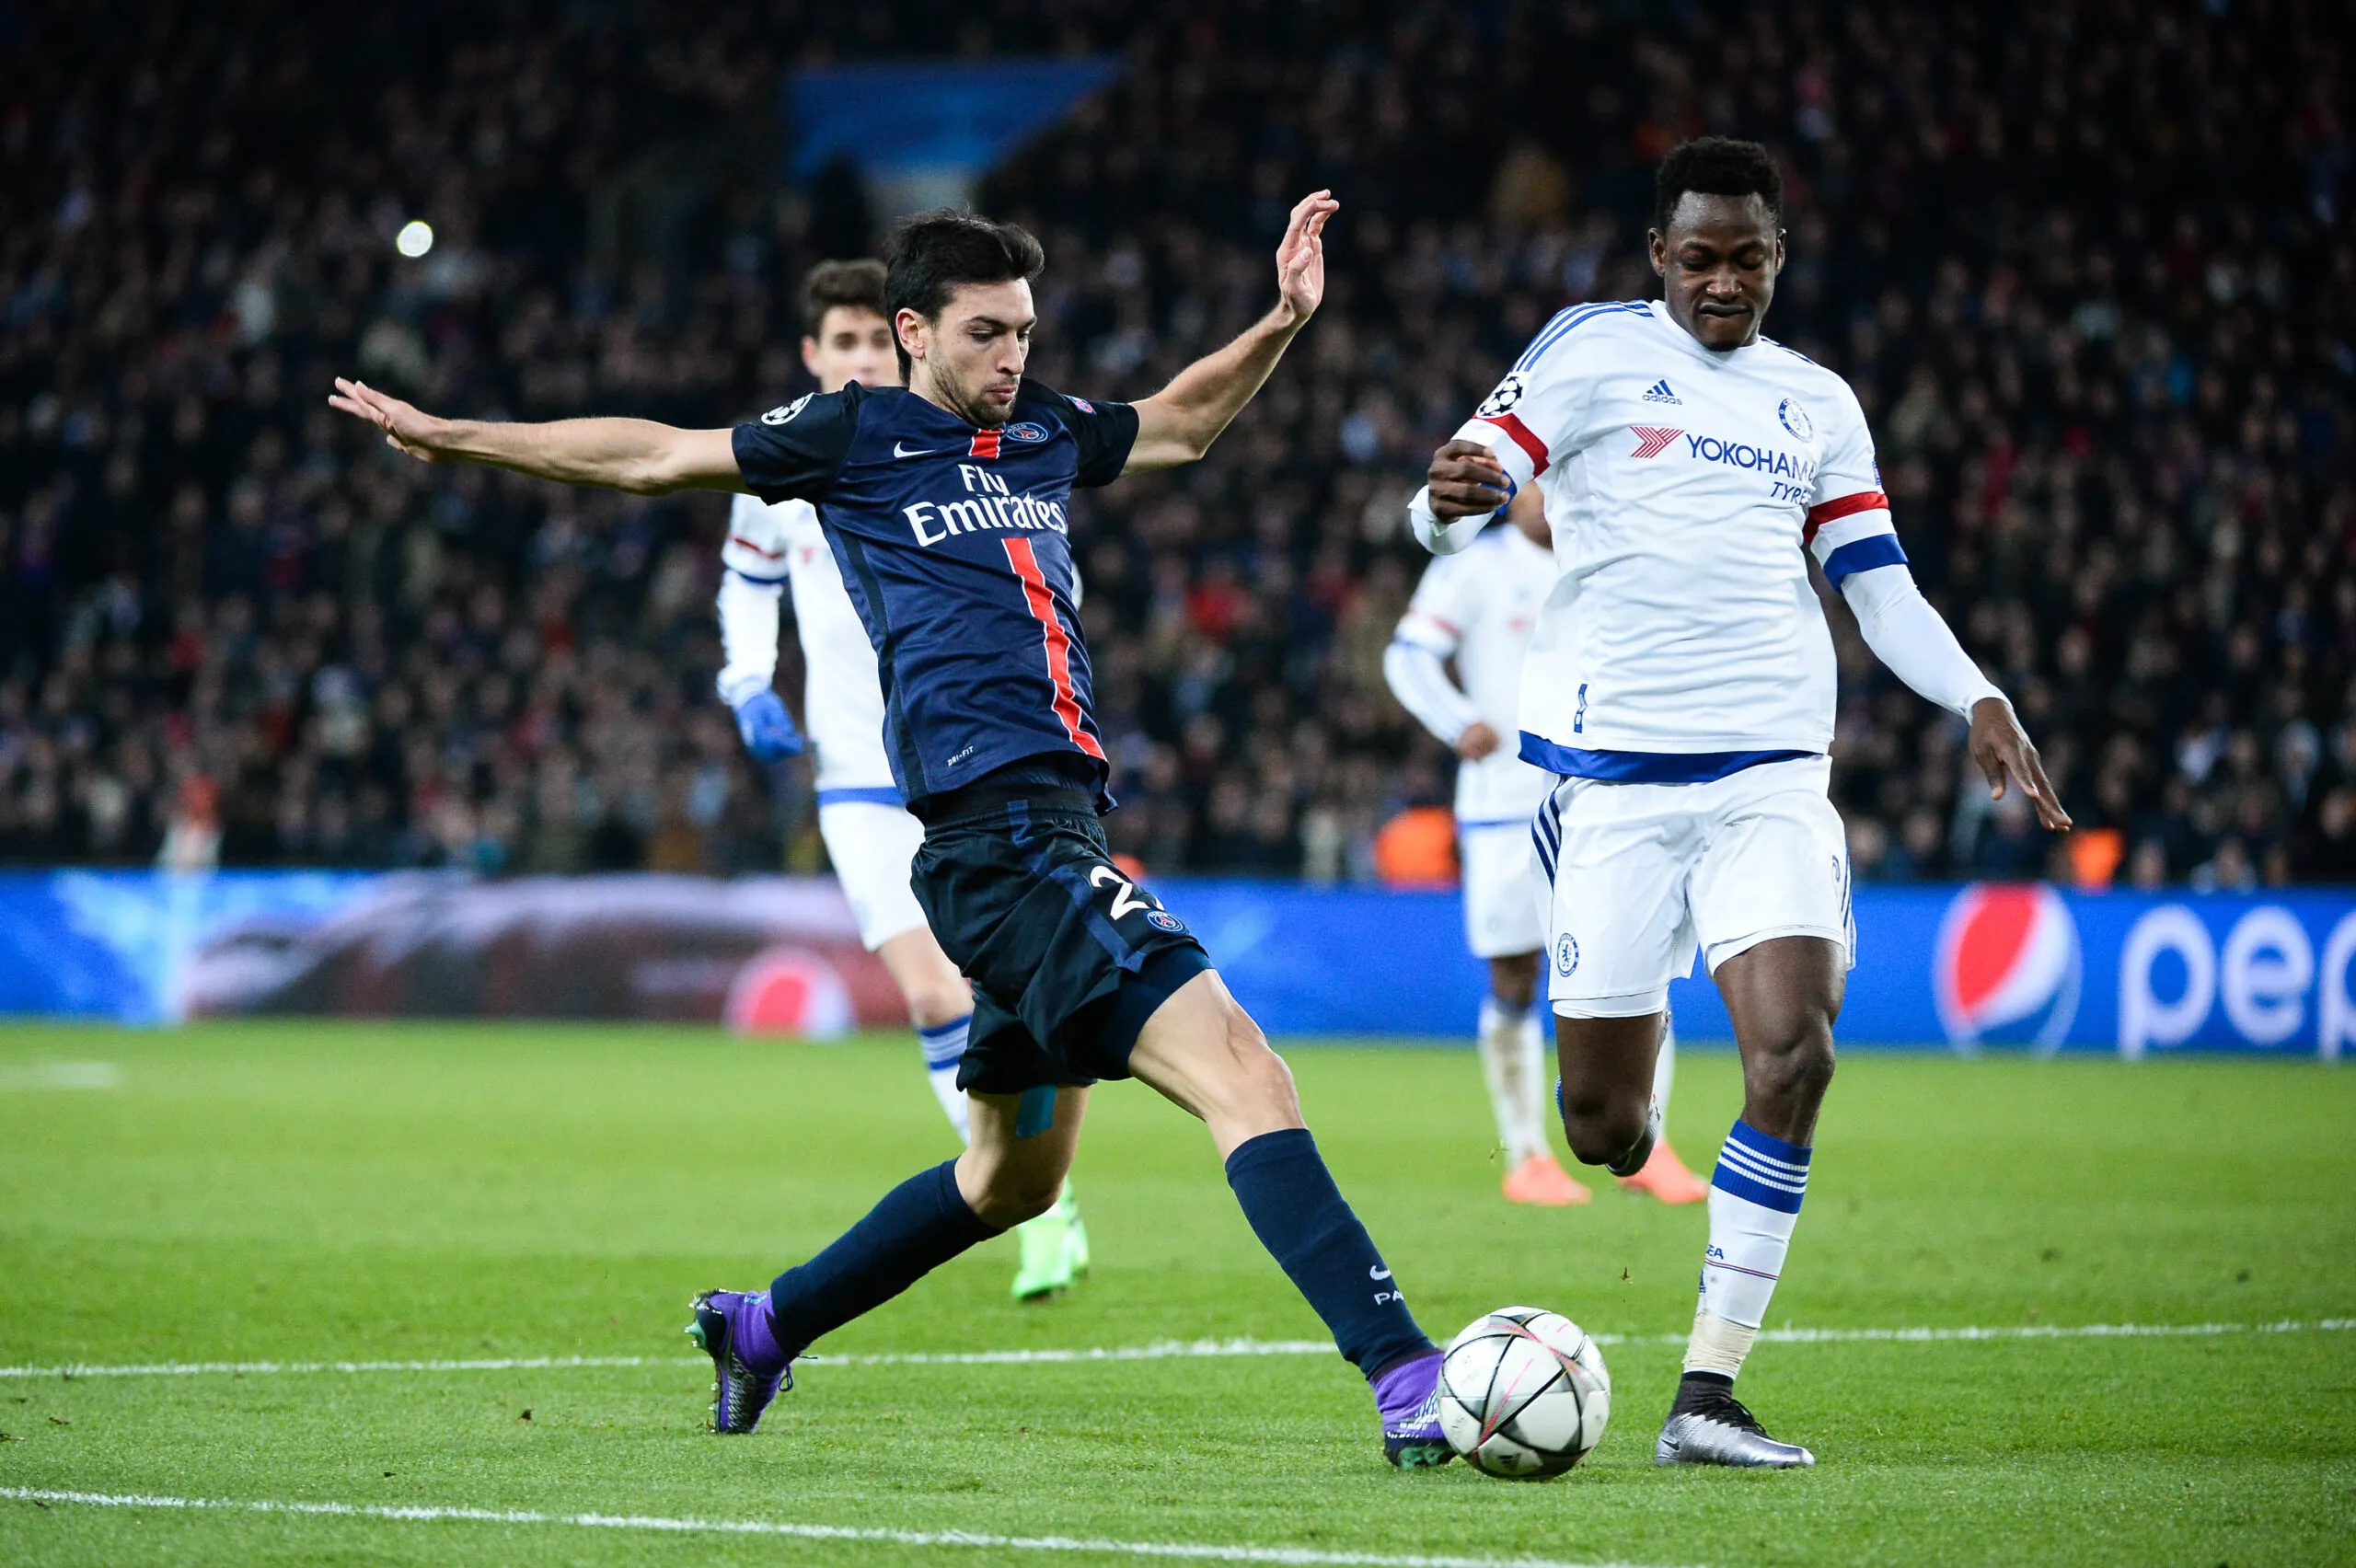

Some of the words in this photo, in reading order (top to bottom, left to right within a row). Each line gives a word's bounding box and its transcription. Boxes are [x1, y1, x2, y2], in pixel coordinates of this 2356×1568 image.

[1642, 394, 1682, 406] adidas
[958, 464, 1010, 496] Fly
[1771, 481, 1808, 505] TYRE
[902, 491, 1067, 547] Emirates
[947, 745, 974, 767] DRI-FIT
[1705, 1244, 1724, 1260] EA
